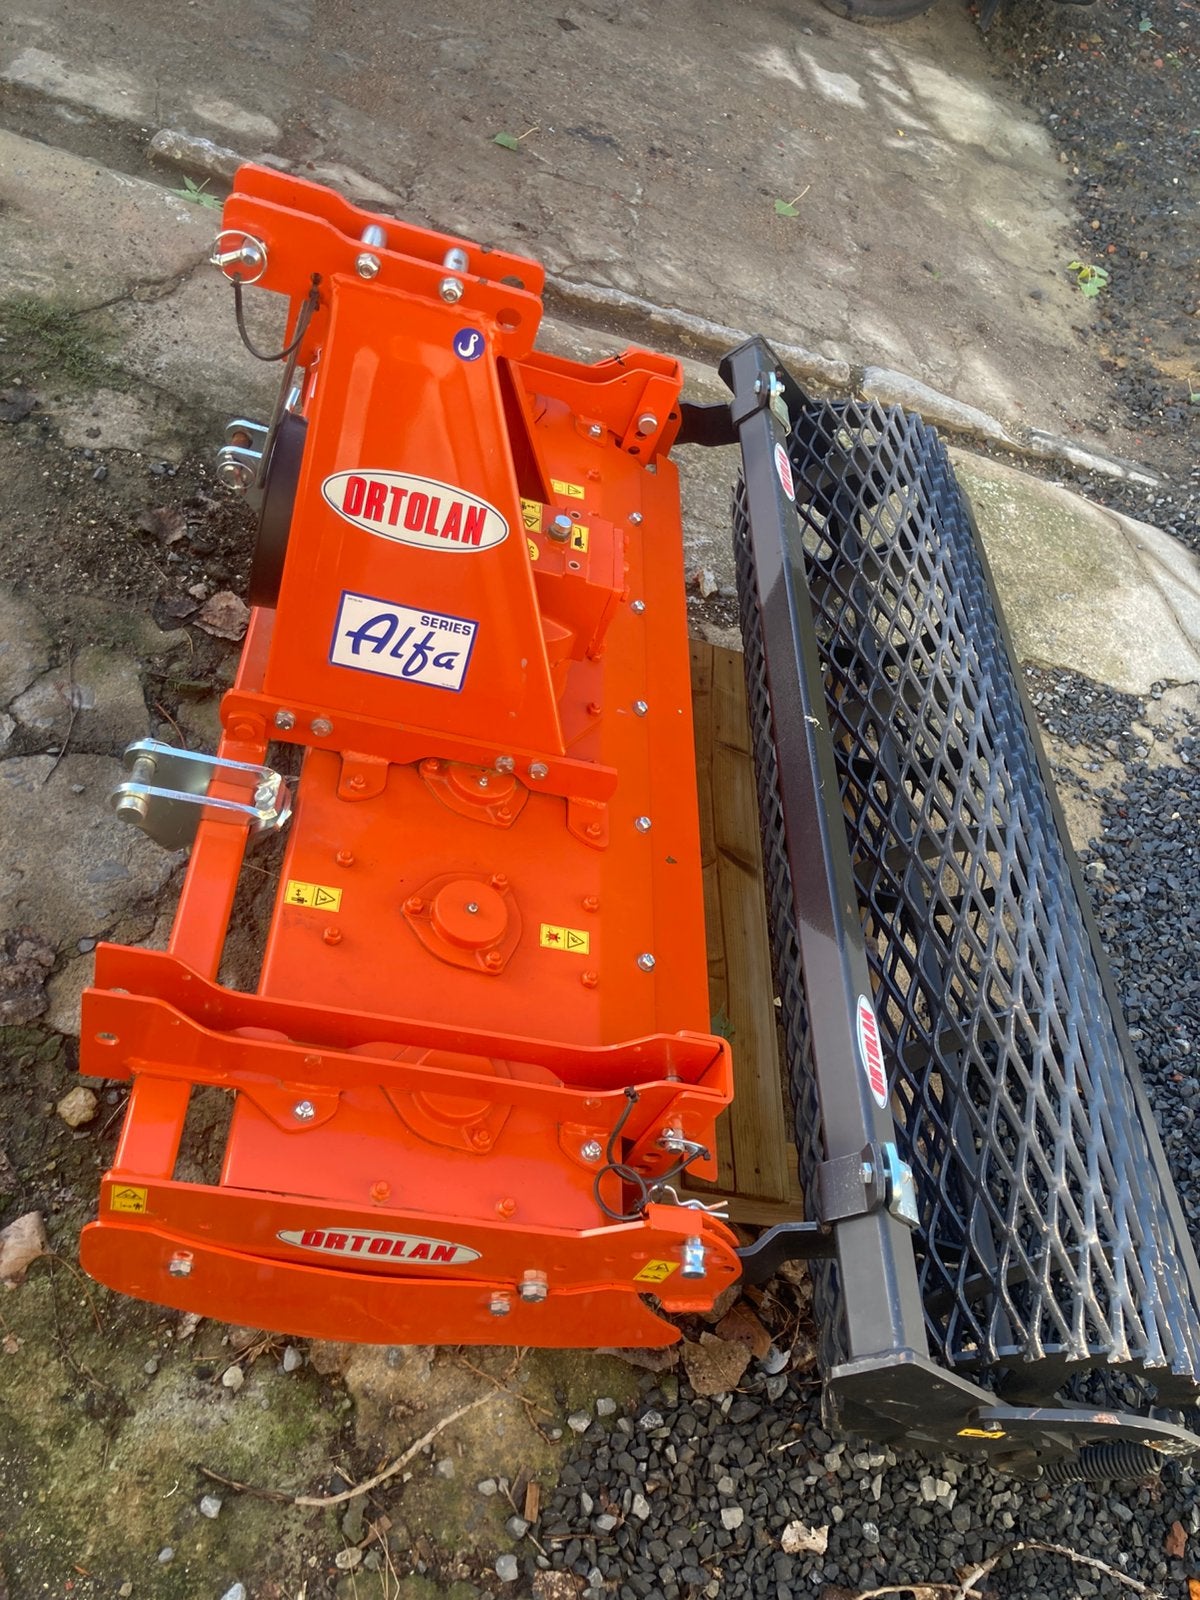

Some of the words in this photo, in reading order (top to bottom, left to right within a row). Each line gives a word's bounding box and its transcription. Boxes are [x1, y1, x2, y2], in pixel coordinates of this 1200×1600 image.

[342, 475, 487, 546] ORTOLAN
[345, 613, 460, 677] Alfa
[420, 615, 471, 636] SERIES
[300, 1231, 458, 1262] ORTOLAN
